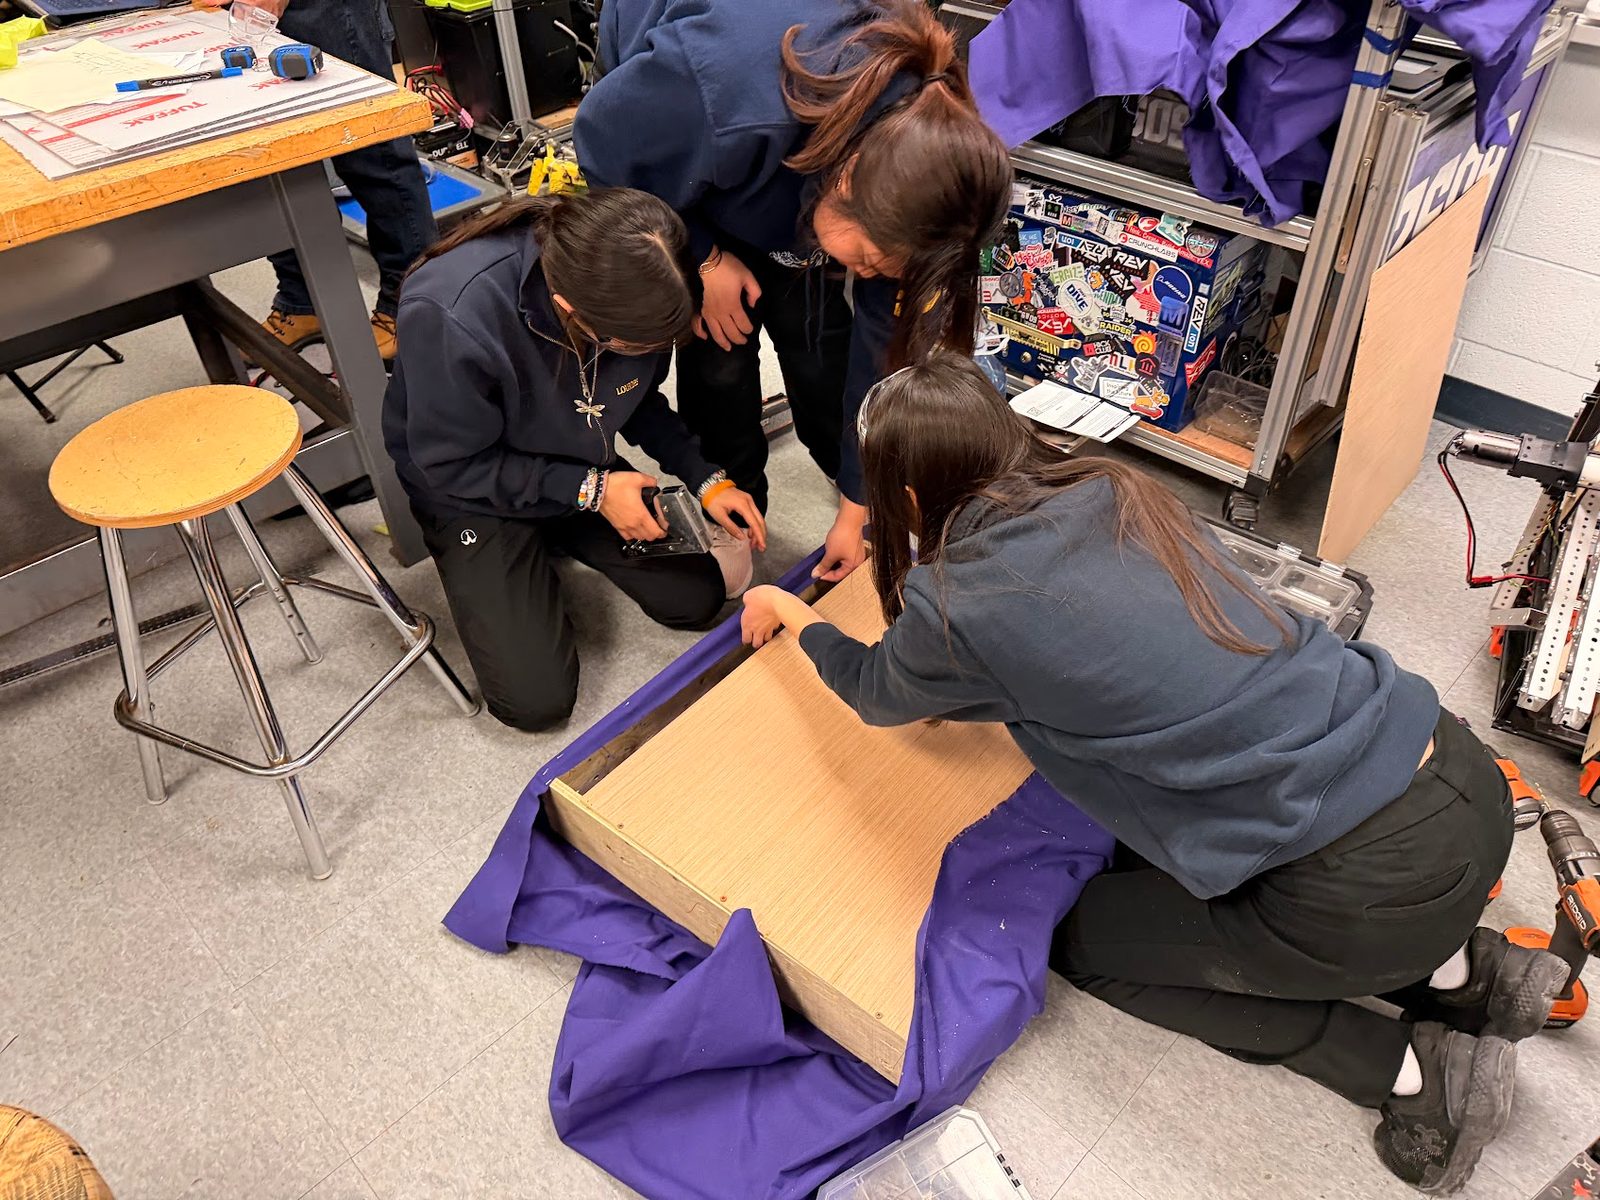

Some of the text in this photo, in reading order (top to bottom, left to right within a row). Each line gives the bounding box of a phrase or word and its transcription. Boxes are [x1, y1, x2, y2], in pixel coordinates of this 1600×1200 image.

[130, 30, 203, 49] TUFFAK
[120, 101, 208, 127] TUFFAK
[432, 141, 469, 158] DUELL
[1128, 237, 1177, 259] CRUNCHLABS
[1113, 251, 1149, 270] REV
[1066, 284, 1089, 312] DIVE
[1192, 297, 1206, 329] REV
[1099, 321, 1133, 336] RAIDER
[1566, 894, 1588, 932] RIDGID
